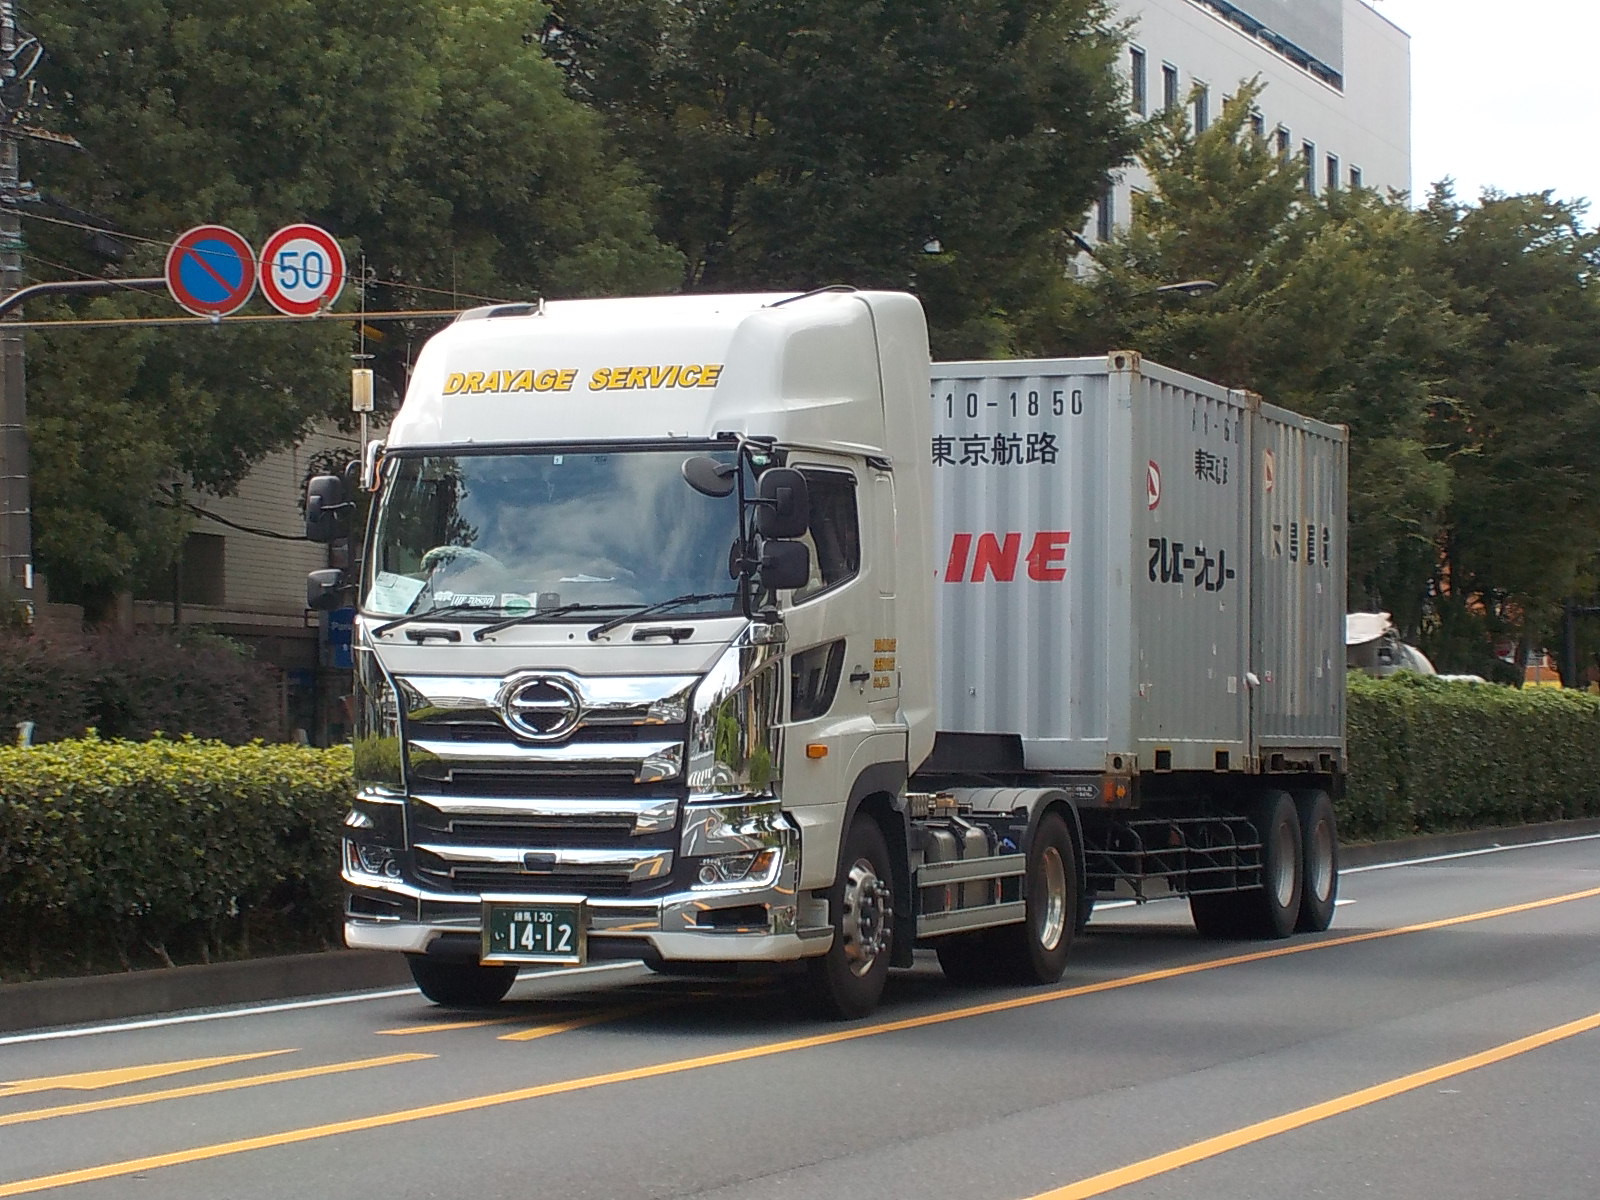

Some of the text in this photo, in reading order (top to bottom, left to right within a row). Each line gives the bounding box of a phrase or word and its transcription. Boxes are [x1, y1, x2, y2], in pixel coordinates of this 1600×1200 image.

[278, 251, 323, 289] 50
[442, 364, 724, 395] DRAYAGE SERVICE
[930, 390, 1083, 418] 10-1850
[931, 432, 1060, 467] 東京航路
[934, 532, 1070, 582] INE
[509, 923, 572, 951] 14-12
